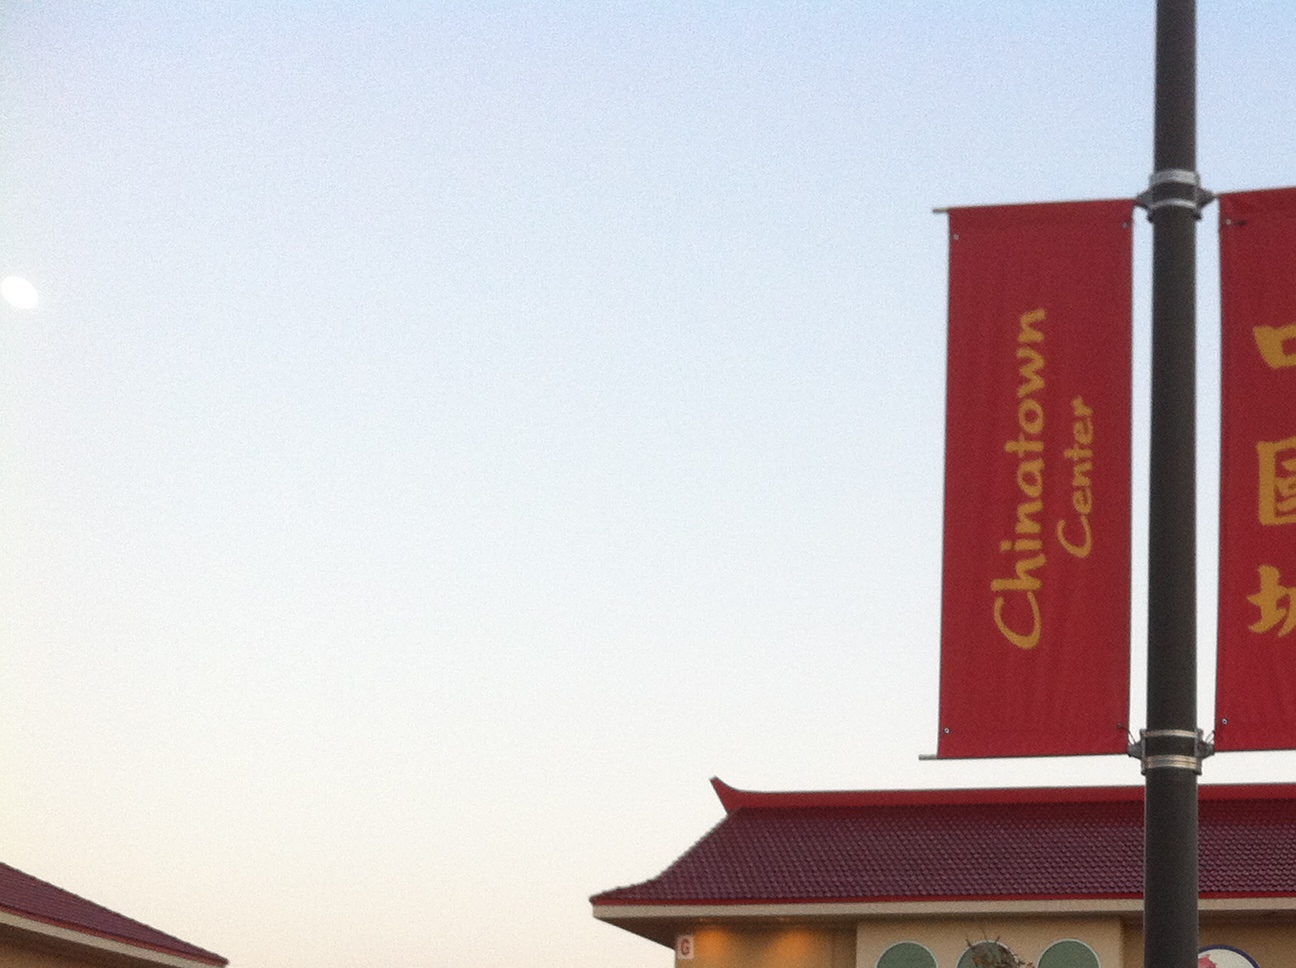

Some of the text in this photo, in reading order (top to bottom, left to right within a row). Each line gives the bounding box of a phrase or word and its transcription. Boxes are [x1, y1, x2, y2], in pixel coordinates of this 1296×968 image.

[990, 306, 1047, 650] Chinatown
[1056, 395, 1095, 559] Center
[680, 938, 691, 956] G
